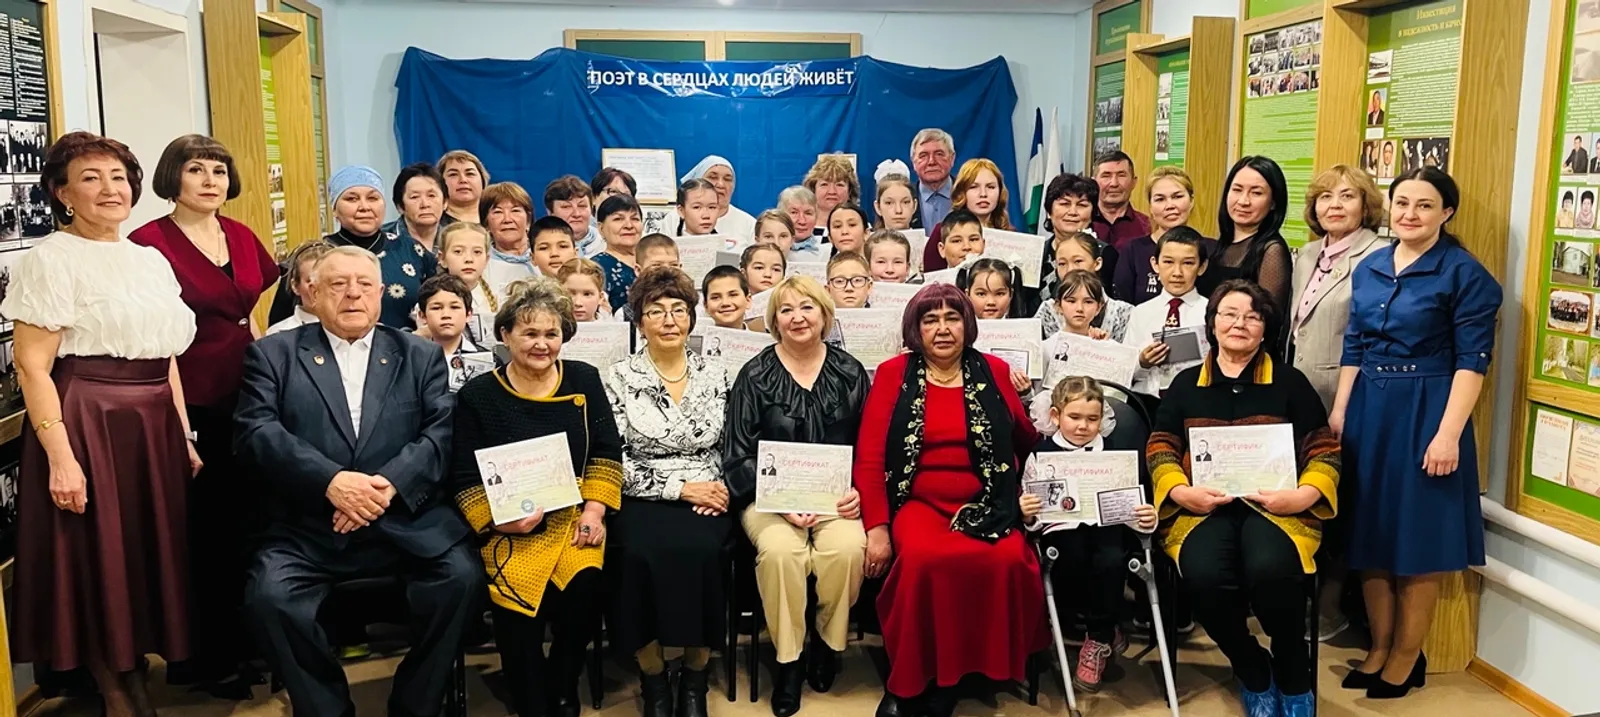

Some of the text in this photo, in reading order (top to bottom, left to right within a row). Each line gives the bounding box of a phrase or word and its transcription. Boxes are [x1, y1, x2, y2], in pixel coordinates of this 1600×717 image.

[590, 67, 855, 90] ПОЭТ В СЕРДЦАХ ЛЮДЕЙ ЖИВЁТ
